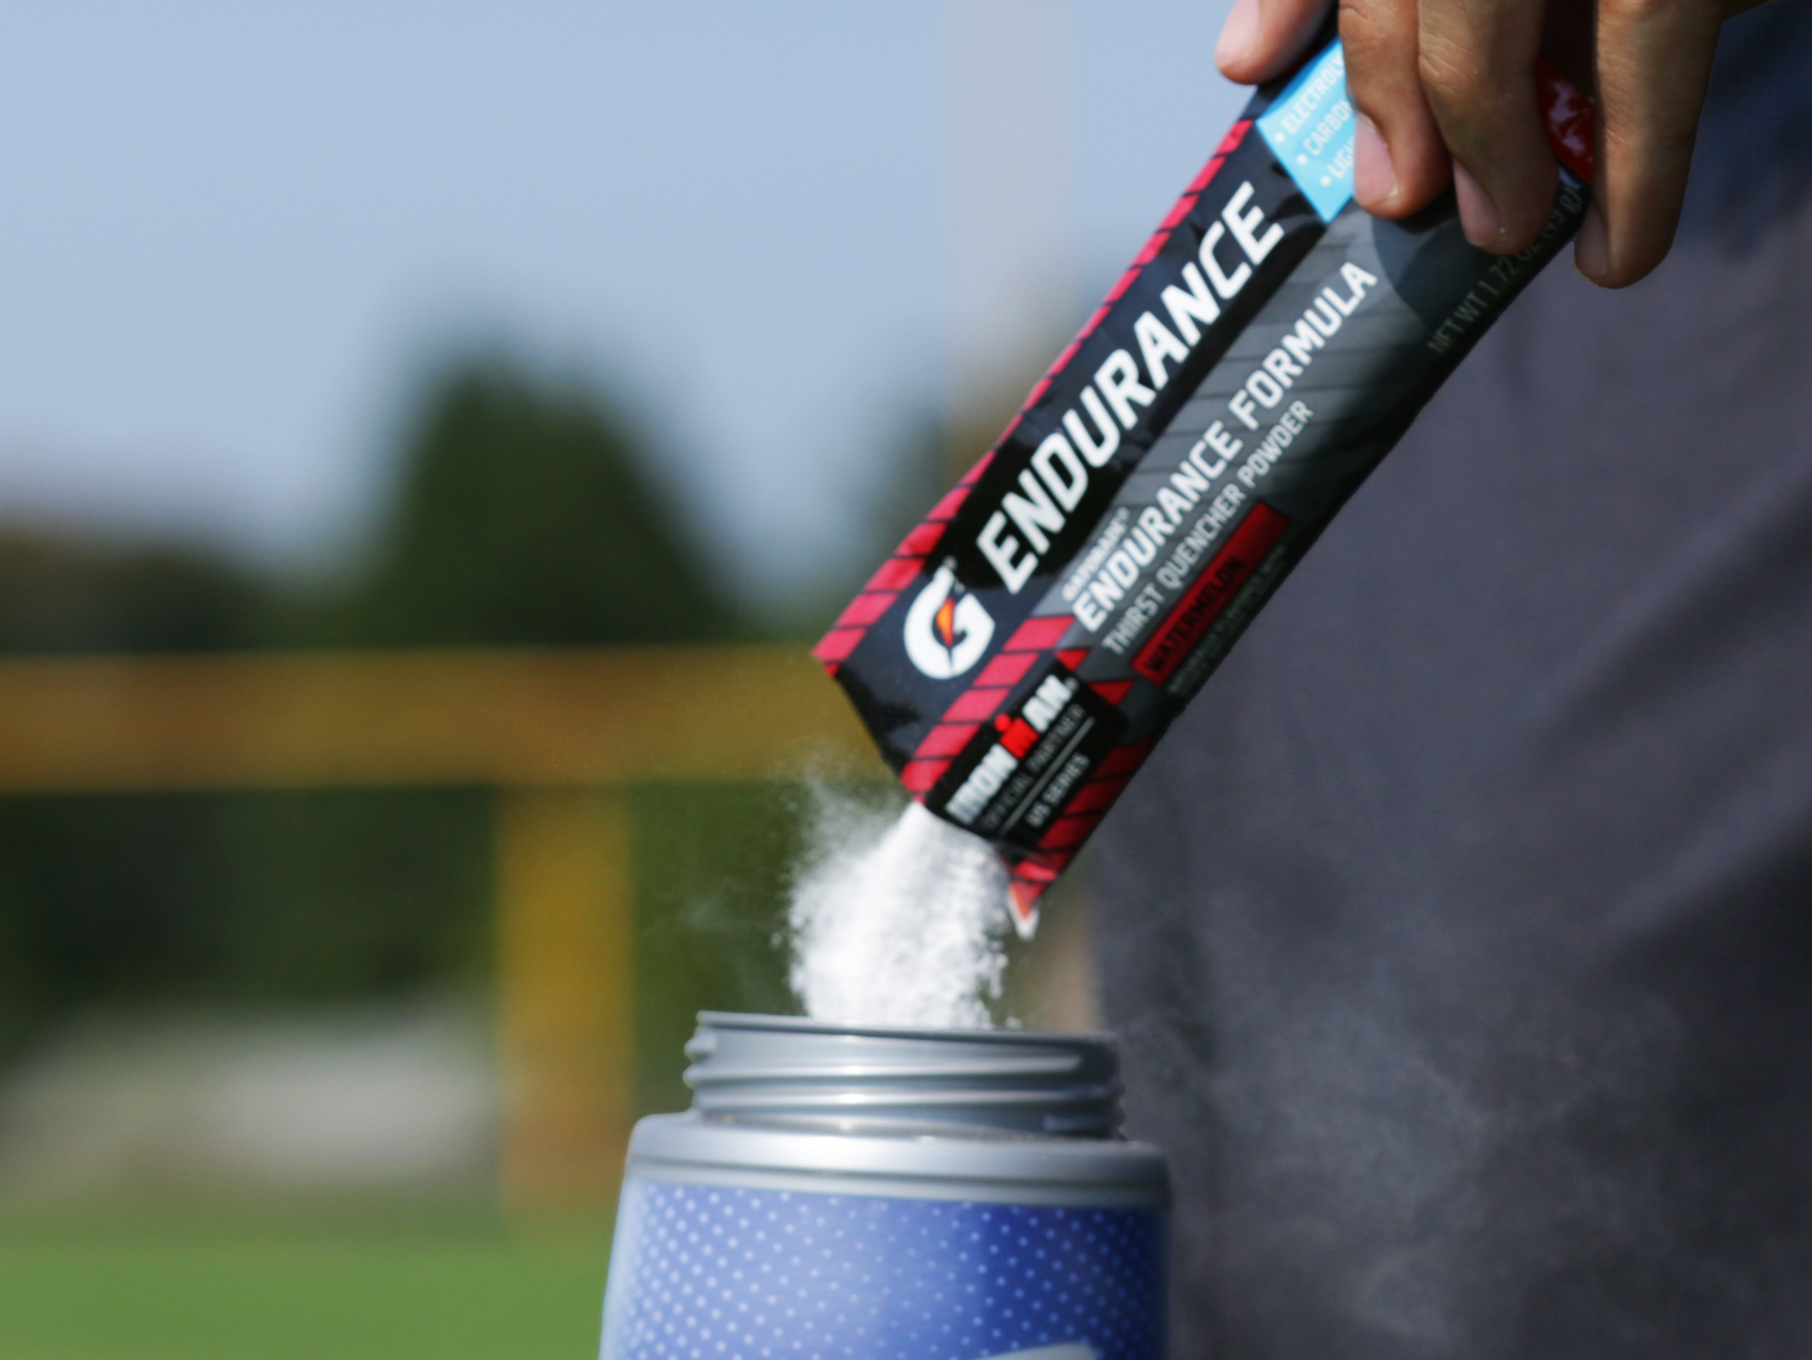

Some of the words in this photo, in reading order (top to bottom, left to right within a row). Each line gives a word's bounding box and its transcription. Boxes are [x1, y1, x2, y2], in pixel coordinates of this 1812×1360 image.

[903, 566, 996, 680] G
[975, 180, 1285, 594] ENDURANCE
[1072, 419, 1244, 633] ENDURANCE
[1227, 261, 1379, 431] FORMULA
[1101, 582, 1165, 655] THIRST
[1156, 483, 1247, 591] QUENCHER
[1236, 398, 1315, 488] POWDER
[1143, 555, 1245, 673] WATERMELON
